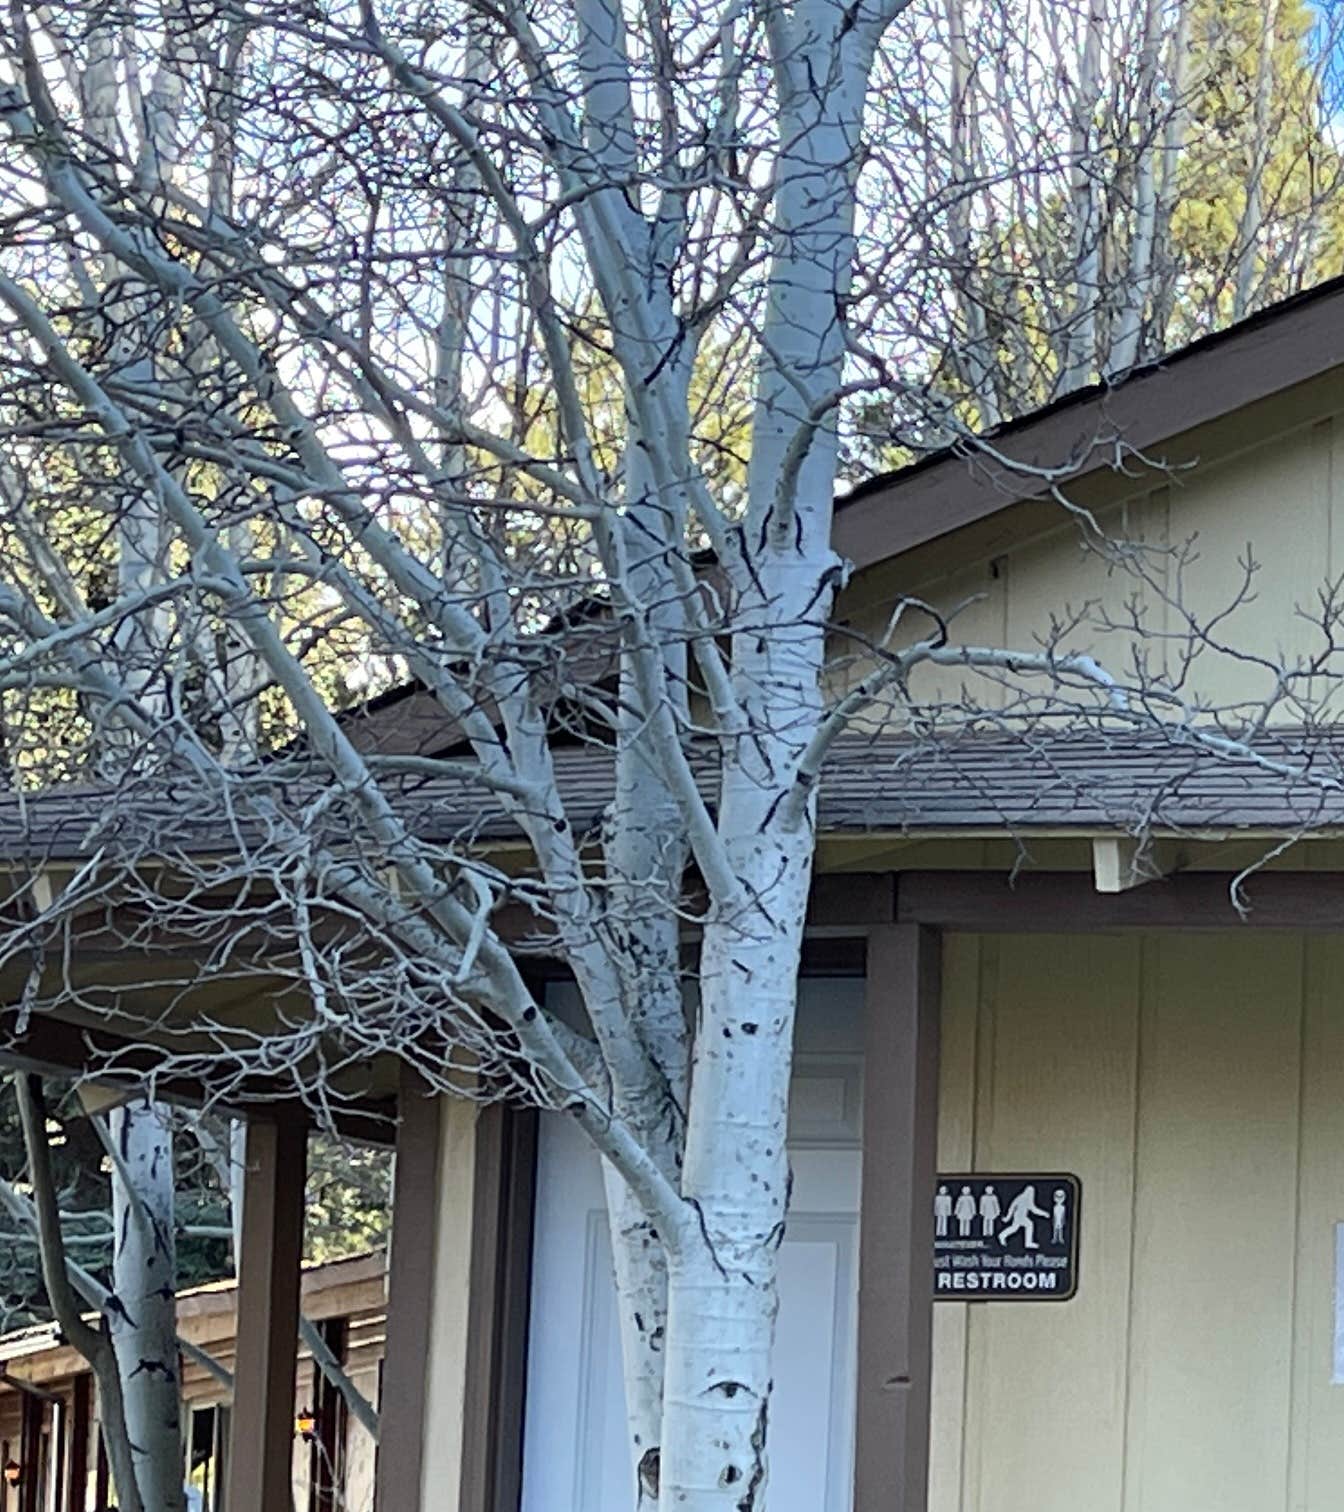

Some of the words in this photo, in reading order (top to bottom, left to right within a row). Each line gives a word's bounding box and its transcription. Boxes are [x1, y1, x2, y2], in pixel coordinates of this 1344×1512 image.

[934, 1255, 950, 1268] ust
[952, 1254, 979, 1268] Wash
[981, 1255, 1001, 1268] Your
[1036, 1253, 1068, 1268] Please
[938, 1271, 1057, 1289] RESTROOM
